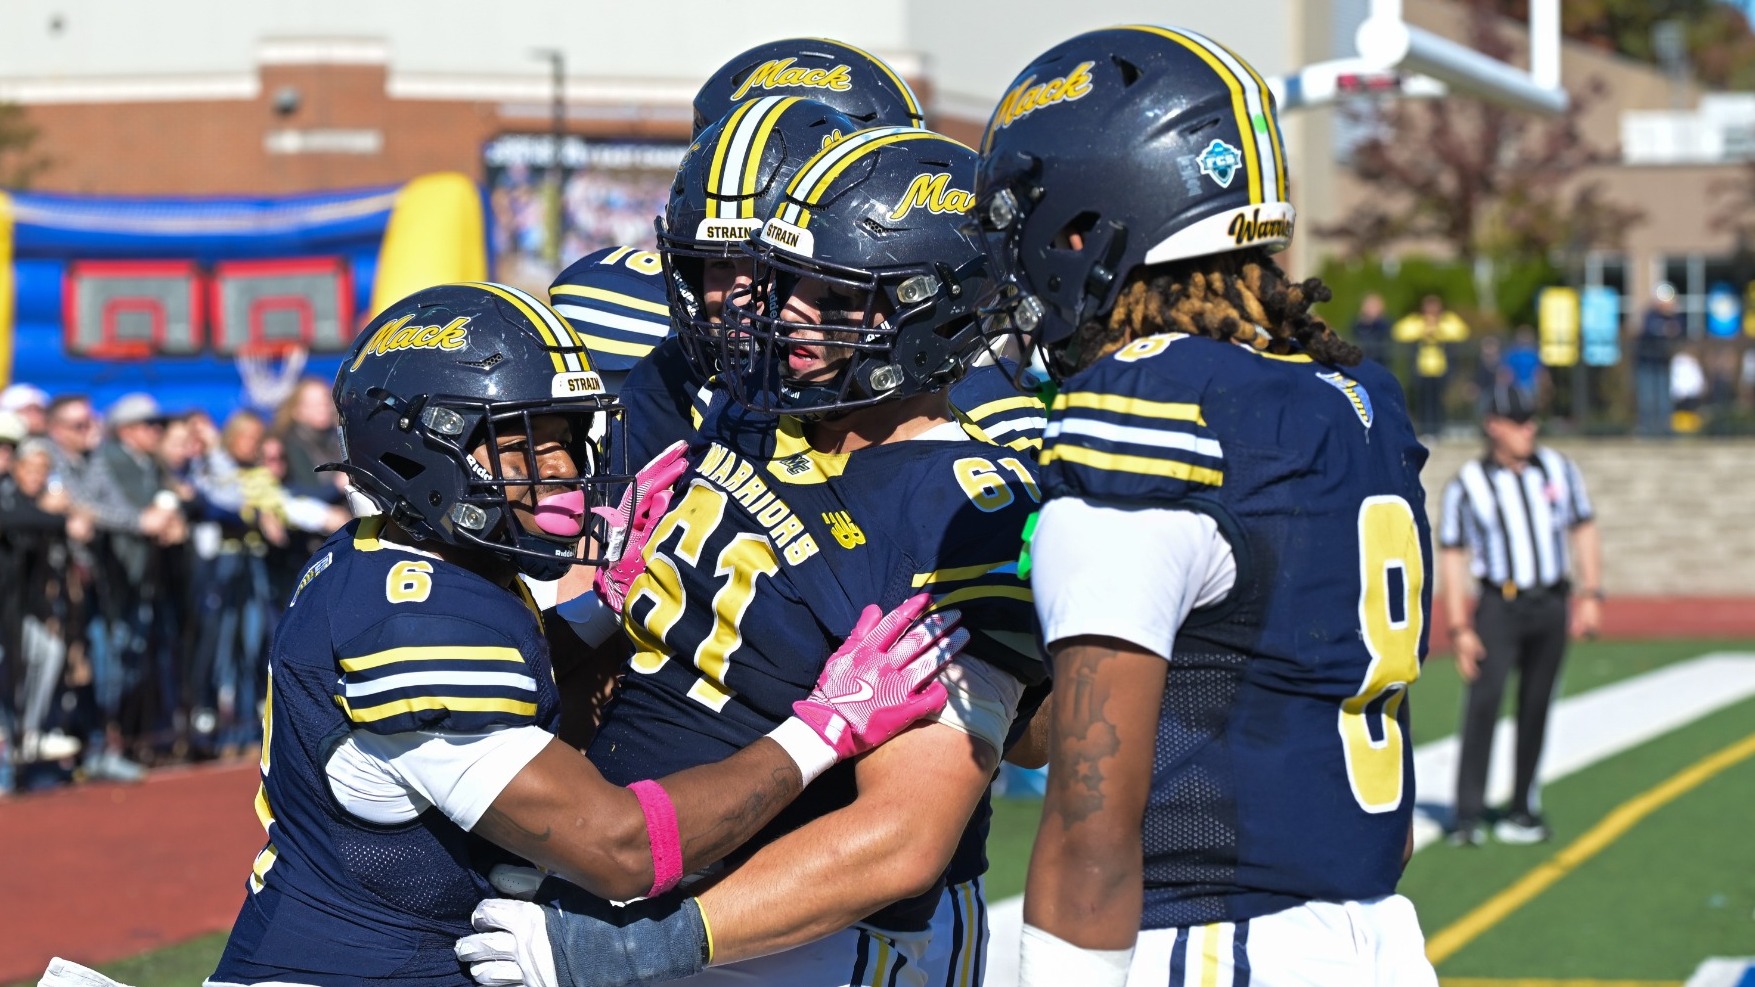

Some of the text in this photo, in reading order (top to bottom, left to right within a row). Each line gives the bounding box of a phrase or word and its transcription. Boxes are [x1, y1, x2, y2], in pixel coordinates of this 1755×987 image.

[729, 57, 853, 102] Mack
[982, 60, 1096, 160] Mack
[706, 225, 752, 240] STRAIN
[766, 222, 801, 248] STRAIN
[1227, 207, 1293, 246] Warri
[349, 313, 473, 373] Mack
[567, 376, 601, 392] STRAIN
[695, 442, 820, 567] WARRIORS
[385, 560, 434, 605] 6
[622, 478, 781, 714] 61
[1338, 494, 1425, 815] 8
